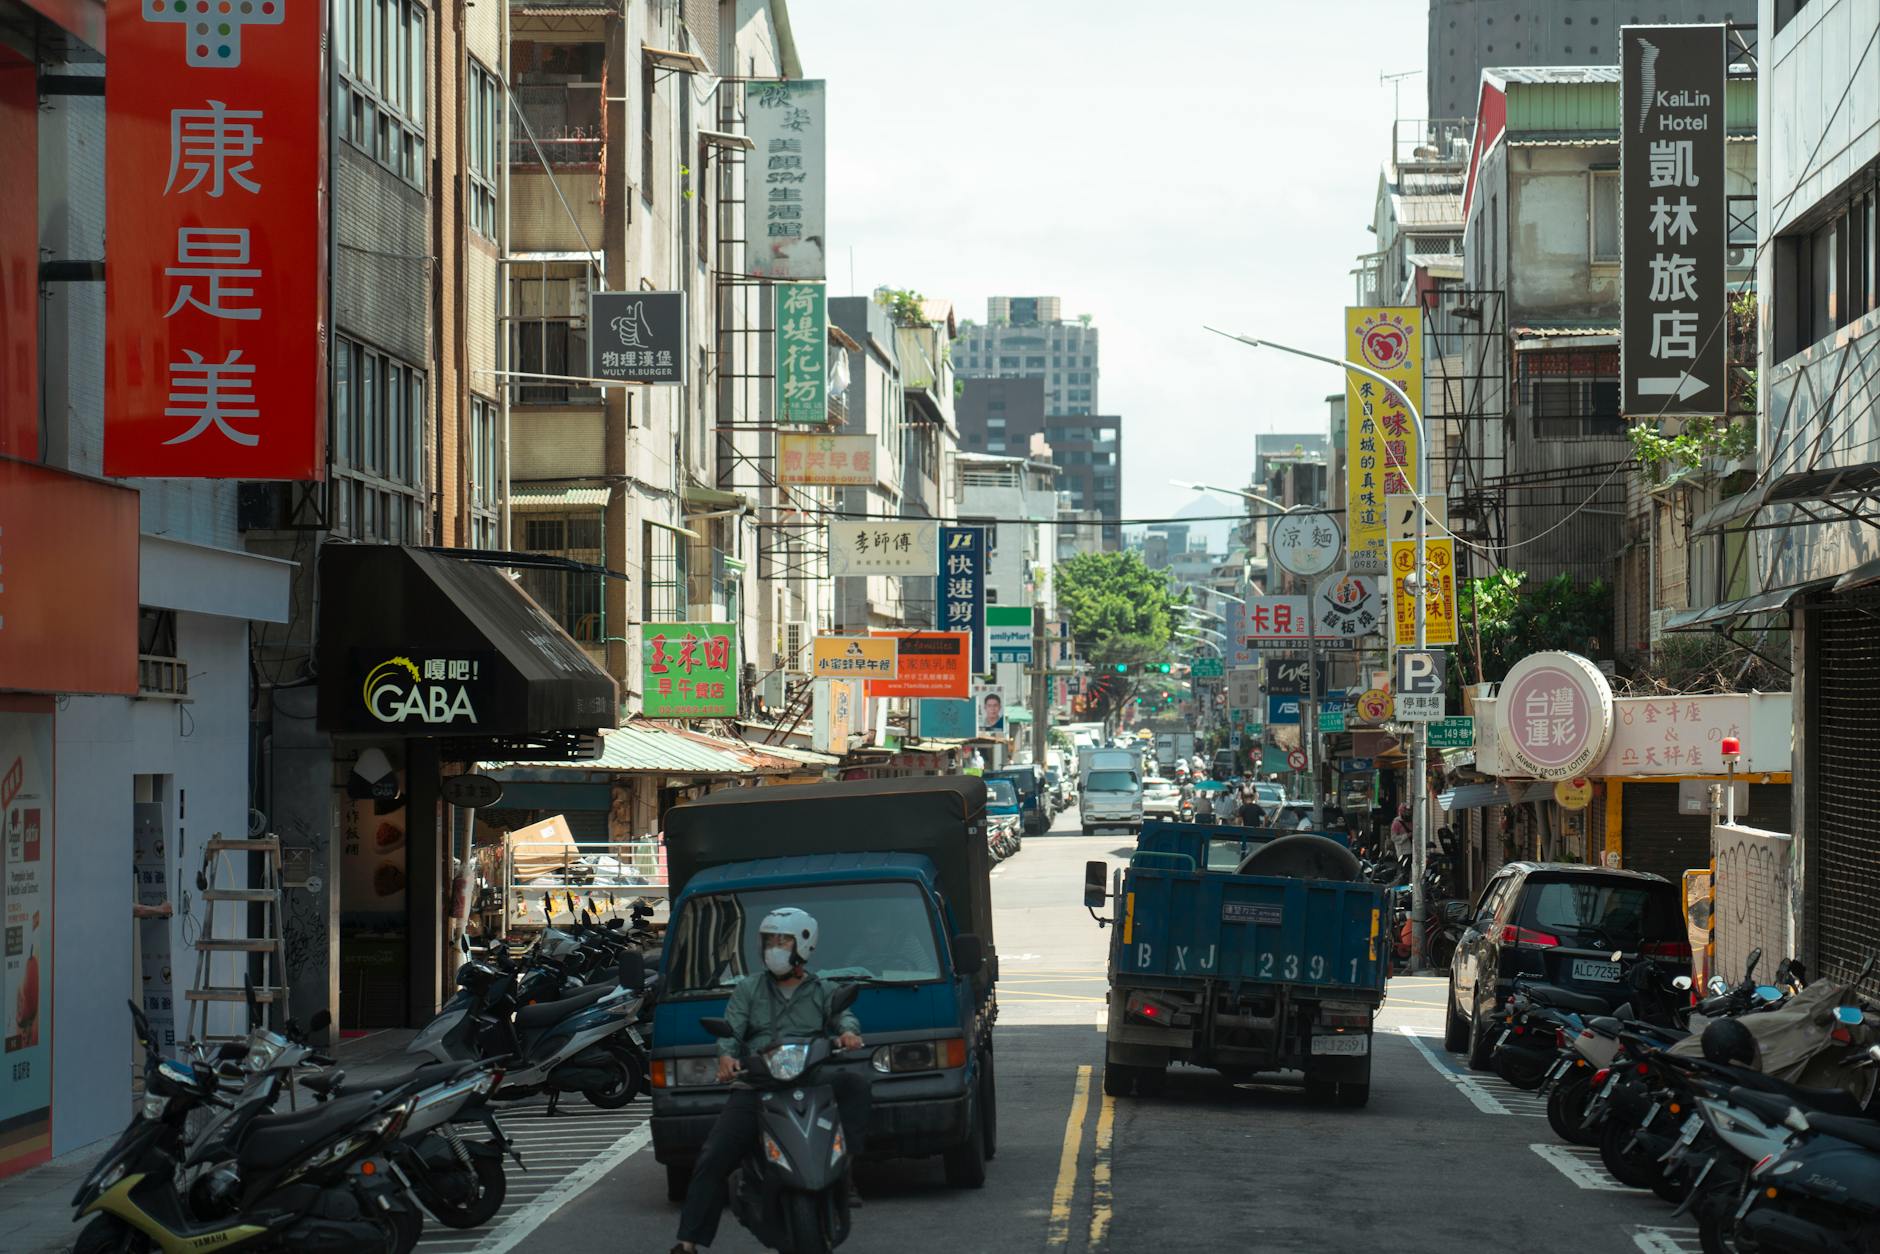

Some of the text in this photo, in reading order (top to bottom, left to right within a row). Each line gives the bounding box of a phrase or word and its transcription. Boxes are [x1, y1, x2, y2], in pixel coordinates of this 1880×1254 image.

[1657, 91, 1710, 107] KaiLin
[1660, 114, 1708, 131] Hotel
[1648, 140, 1700, 360] 凱林旅店
[162, 100, 263, 446] 康是美
[601, 350, 673, 367] 物理漢堡
[602, 368, 673, 376] WULY H.BURGER
[854, 530, 912, 554] 李師傅
[1281, 526, 1333, 549] 涼麵
[947, 555, 974, 632] 快速剪
[990, 632, 1030, 642] amilyMart
[424, 658, 479, 681] 嘎吧!
[818, 657, 891, 671] 小蜜蜂早午餐
[1404, 653, 1433, 690] P
[371, 684, 478, 724] GABA
[1403, 696, 1440, 708] 停車場
[1525, 687, 1574, 716] 台灣
[1642, 702, 1702, 724] 金牛座
[1526, 717, 1576, 747] 運彩
[1665, 727, 1678, 742] &
[1515, 748, 1592, 778] TAIWAN SPORTS LOTTERY
[1644, 745, 1703, 766] 天秤座
[1138, 943, 1215, 971] BXJ
[1260, 953, 1358, 983] 2391
[192, 1232, 229, 1248] YAMAHA
